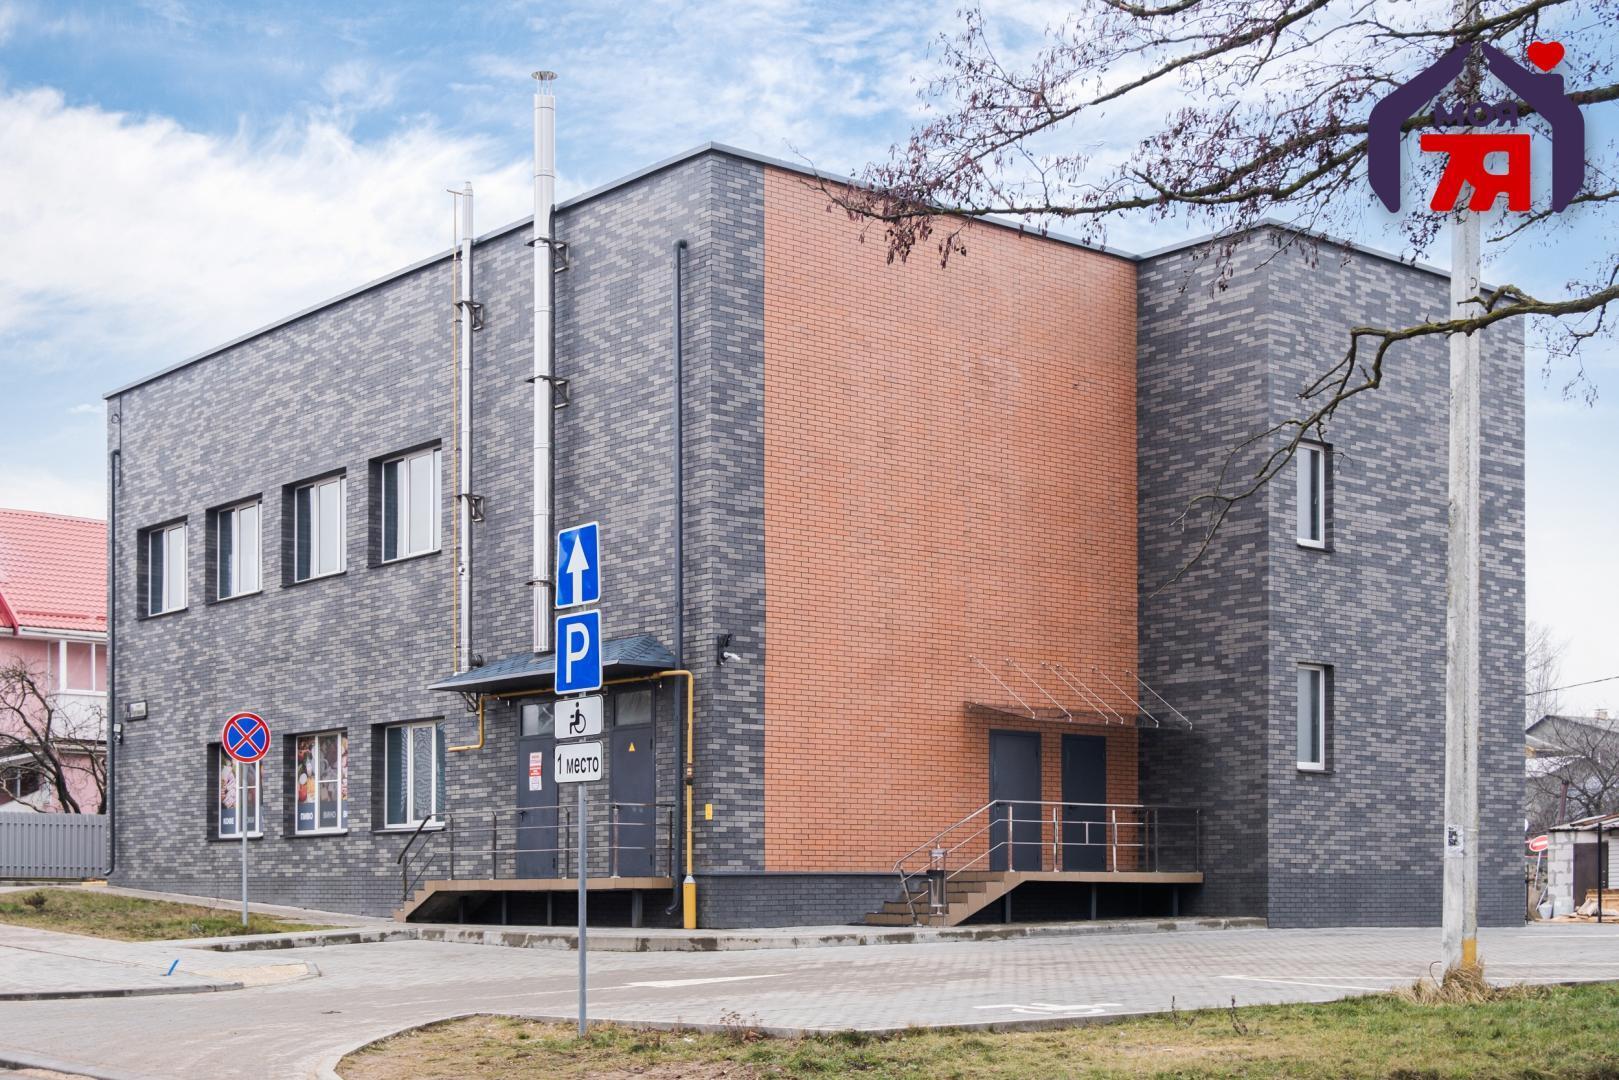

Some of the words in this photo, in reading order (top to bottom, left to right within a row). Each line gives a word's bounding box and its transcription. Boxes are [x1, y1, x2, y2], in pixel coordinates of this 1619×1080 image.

[565, 622, 591, 684] P
[557, 753, 562, 775] 1
[566, 756, 599, 774] место
